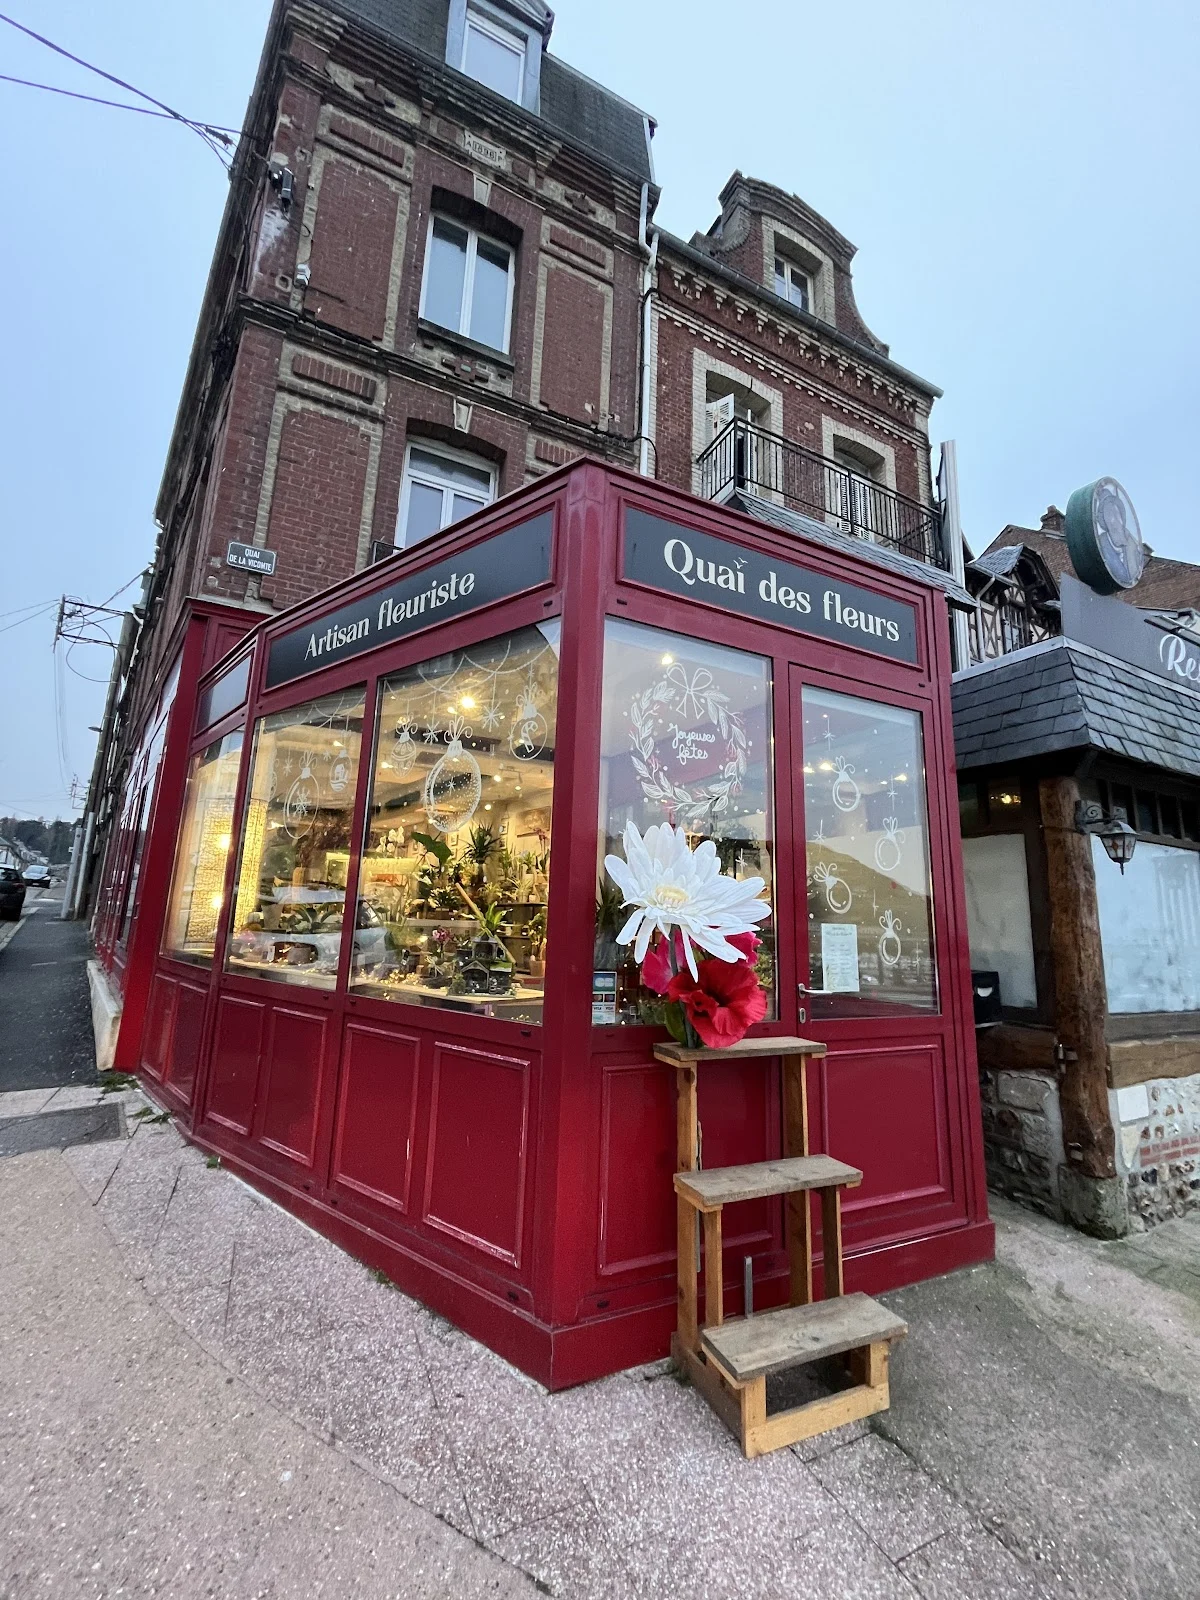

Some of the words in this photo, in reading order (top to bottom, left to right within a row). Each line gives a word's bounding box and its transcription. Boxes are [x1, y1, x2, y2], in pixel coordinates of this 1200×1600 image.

[229, 554, 238, 563] DE
[238, 556, 246, 565] LA
[248, 559, 272, 571] VICOMTE
[244, 549, 260, 558] QUAI
[664, 538, 747, 594] Quai
[758, 571, 812, 614] des
[823, 590, 900, 642] fleurs
[304, 617, 370, 660] Artisan
[377, 572, 475, 631] fleuriste
[1159, 634, 1200, 682] Re
[667, 722, 716, 749] Joyeuses
[676, 743, 708, 765] fêtes
